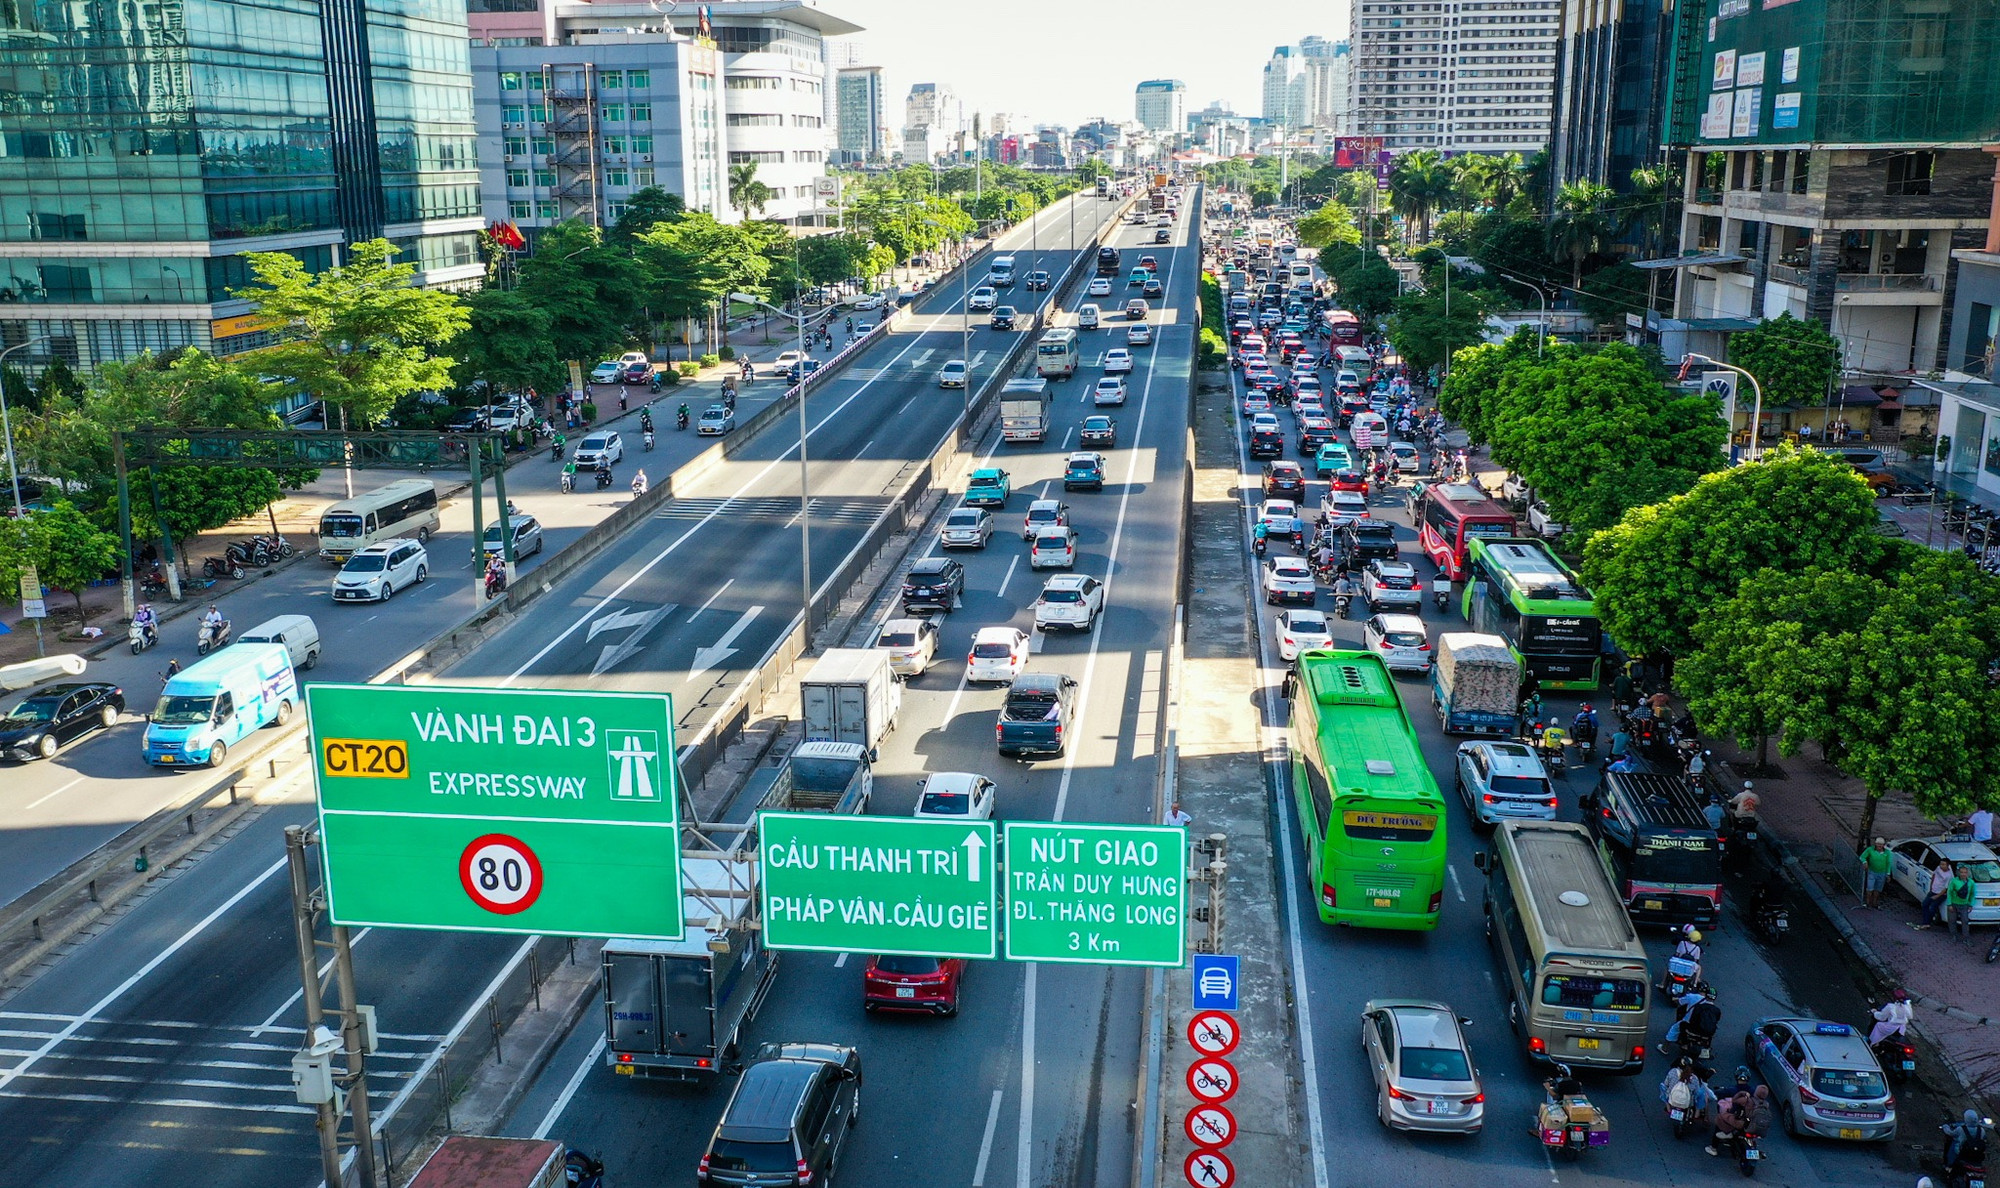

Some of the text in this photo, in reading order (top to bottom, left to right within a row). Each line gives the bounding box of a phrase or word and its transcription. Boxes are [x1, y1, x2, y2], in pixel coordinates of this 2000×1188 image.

[410, 706, 596, 748] VÀNH ĐAI 3
[325, 742, 406, 774] CT.20
[429, 771, 587, 799] EXPRESSWAY
[768, 836, 958, 876] CẦU THANH TRÌ
[1030, 831, 1158, 867] NÚT GIAO
[478, 857, 523, 892] 80
[1013, 866, 1177, 897] TRẦN DUY HƯNG
[770, 893, 835, 923] PHÁP
[948, 900, 988, 930] GIẼ
[1125, 904, 1177, 926] LONG
[1068, 931, 1120, 952] 3 Km
